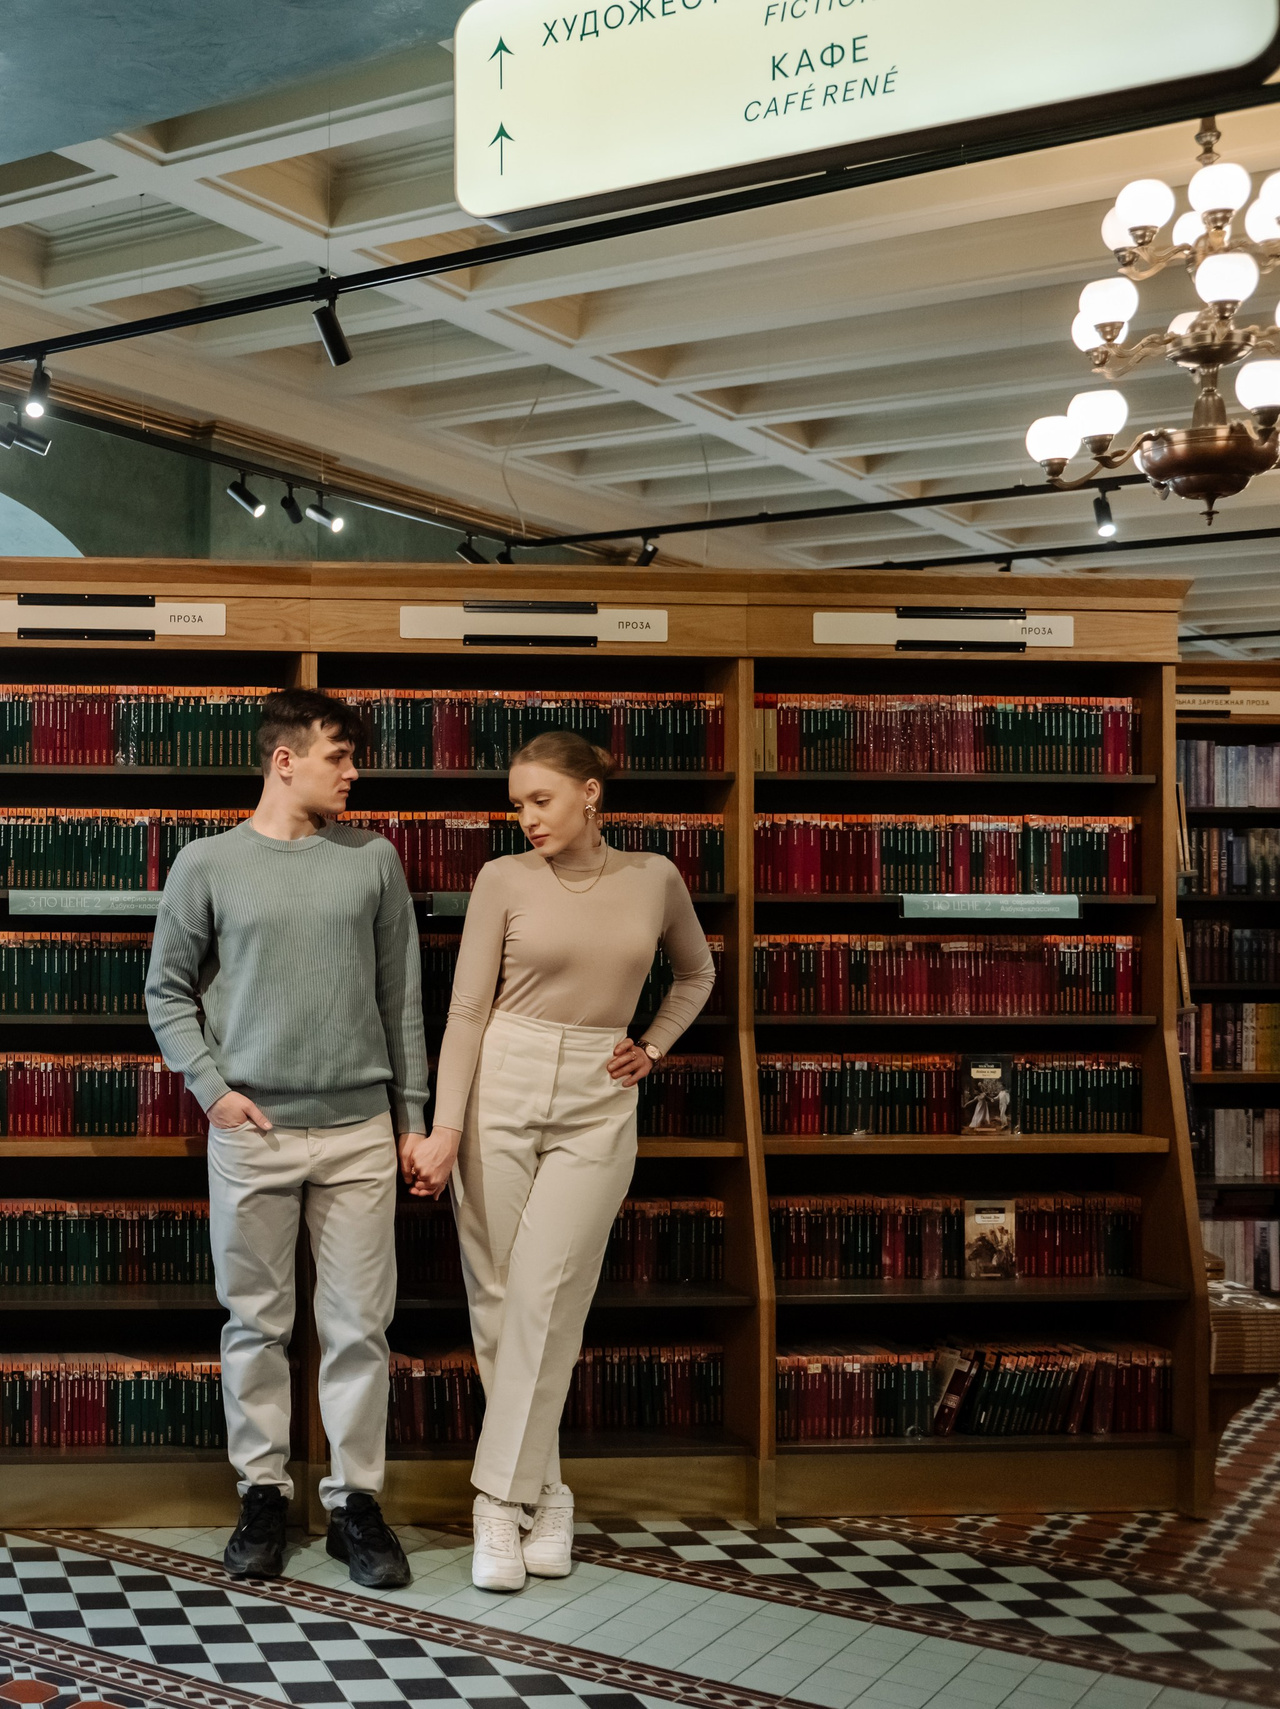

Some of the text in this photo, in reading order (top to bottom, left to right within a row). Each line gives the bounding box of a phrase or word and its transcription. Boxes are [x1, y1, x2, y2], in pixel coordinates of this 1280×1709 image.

[771, 34, 869, 81] КАФЕ
[743, 65, 899, 122] CAFÉ RENÉ
[169, 614, 204, 624] ПРОЗА
[617, 621, 651, 630] ПРОЗА
[1020, 626, 1053, 636] ПРОЗА
[28, 897, 101, 909] 3 ПО ЦЕНЕ 2
[922, 901, 929, 911] 3
[952, 901, 981, 912] ЦЕНЕ
[984, 901, 992, 911] 2
[1000, 905, 1060, 913] Азбука-классика
